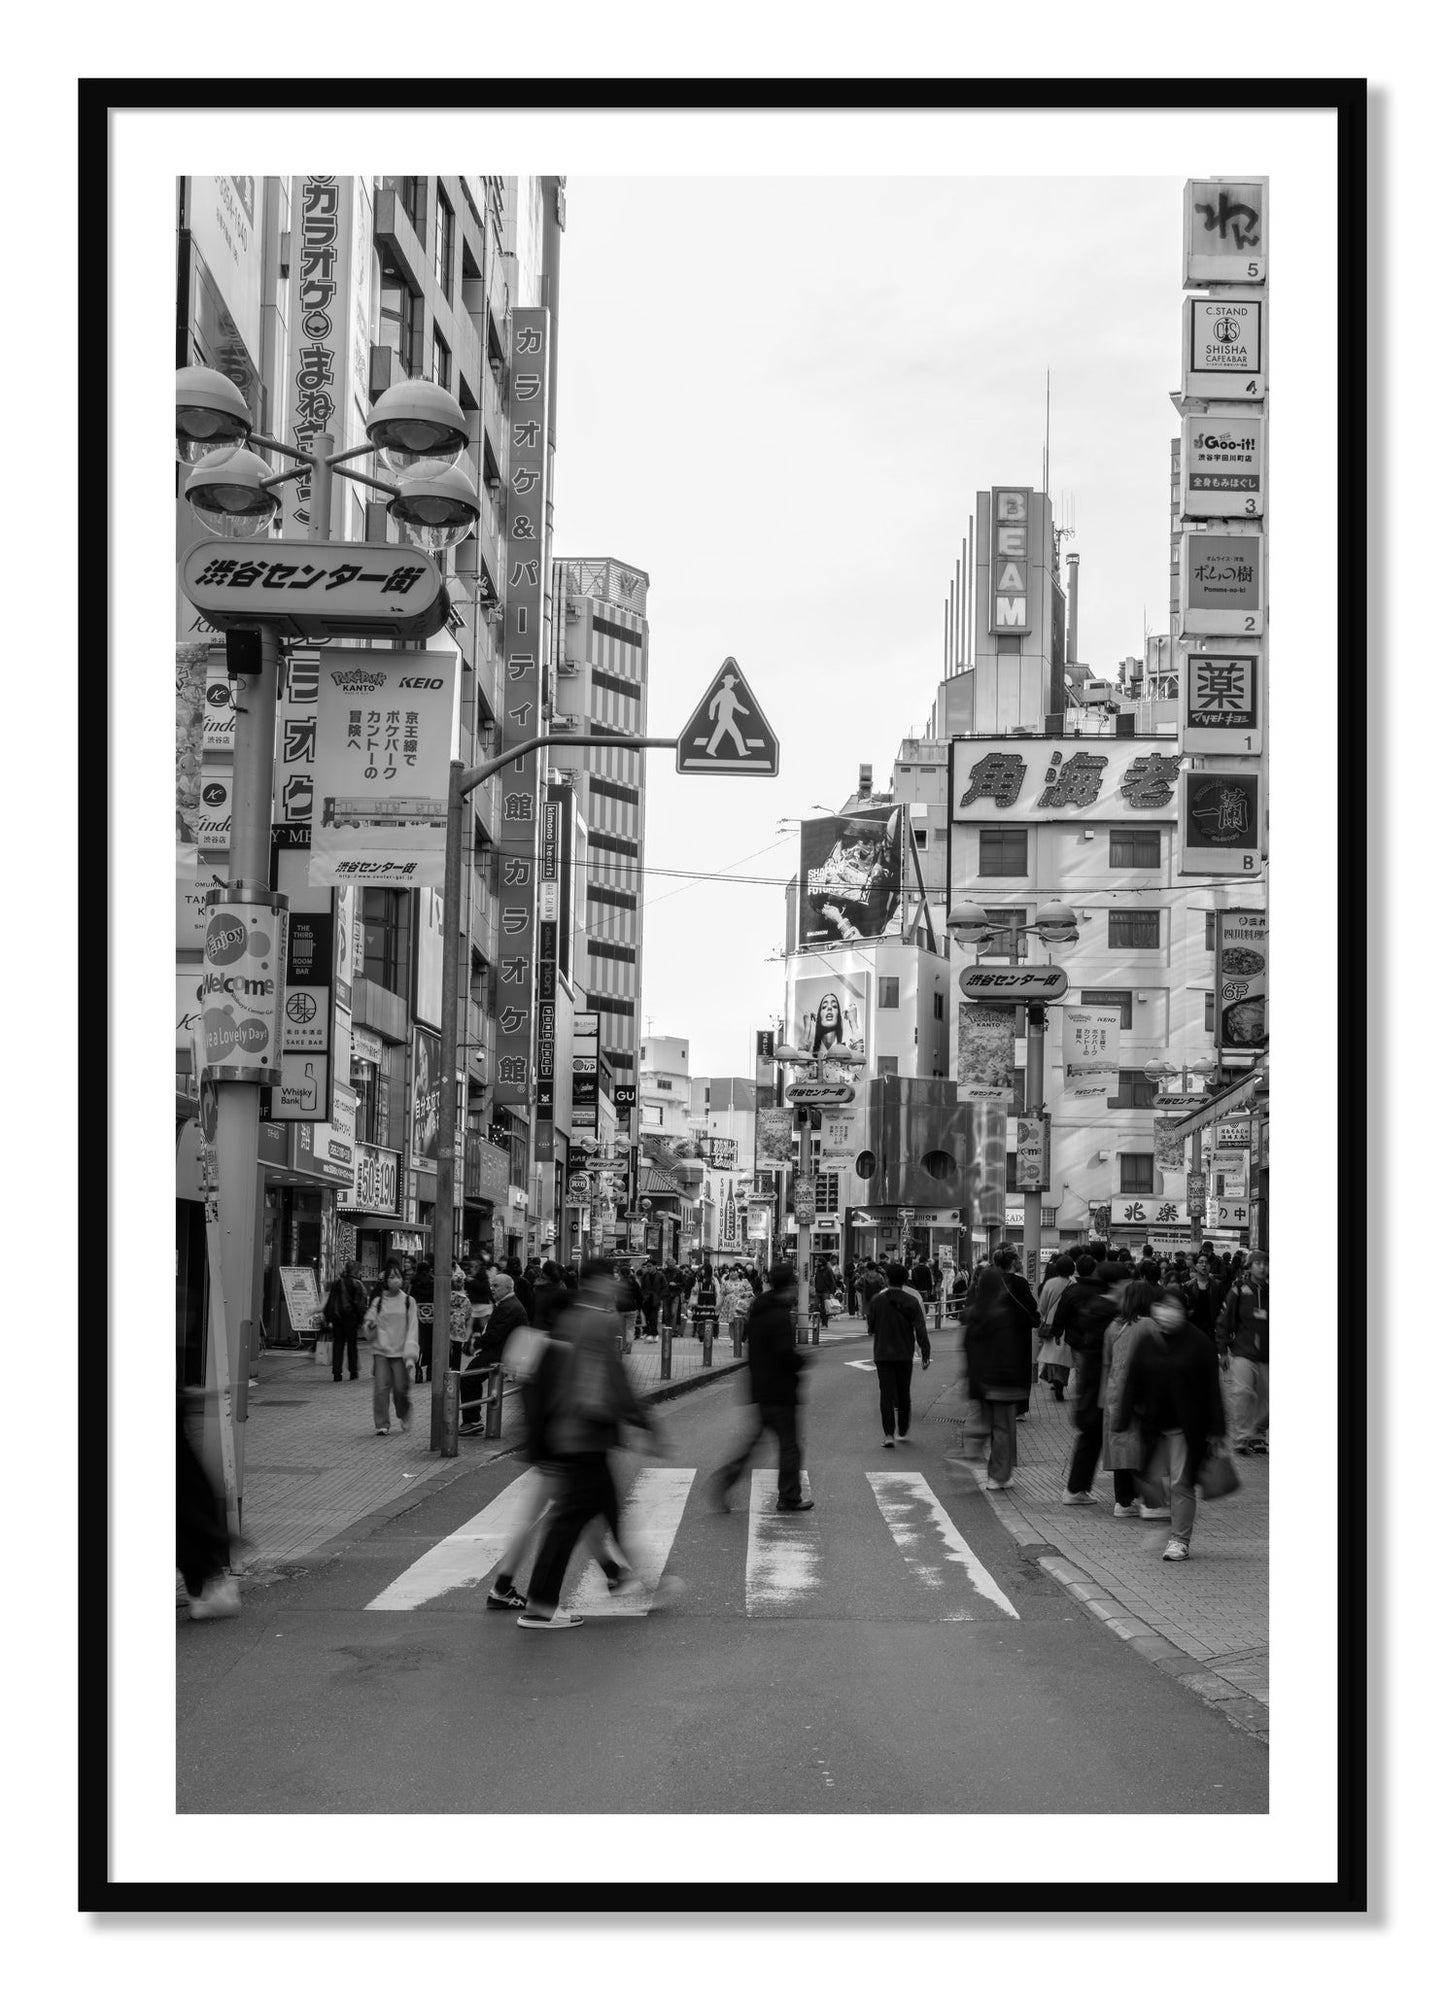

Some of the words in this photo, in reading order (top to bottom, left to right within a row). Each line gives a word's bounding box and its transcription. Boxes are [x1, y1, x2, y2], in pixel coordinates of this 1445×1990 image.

[300, 184, 338, 312] カラオケ
[1248, 262, 1259, 277] 5
[1206, 307, 1248, 316] C.STAND
[1206, 344, 1247, 355] SHISHA
[1246, 380, 1257, 395] 4
[1204, 435, 1255, 450] Goo-it!
[1193, 477, 1256, 489] 全身もみほぐし
[1245, 498, 1256, 514] 3
[997, 492, 1026, 626] BEAM
[195, 558, 427, 594] 渋谷センター街
[1245, 617, 1256, 631] 2
[398, 677, 443, 689] KEIO
[1197, 662, 1244, 709] 薬
[347, 710, 362, 750] 冒険へ
[364, 710, 380, 779] カントーの
[403, 712, 418, 766] 京王線で
[1244, 736, 1252, 750] 1
[960, 751, 1180, 808] 角海老
[1192, 787, 1248, 833] 一蘭
[546, 807, 555, 840] kimono
[335, 861, 418, 873] 渋谷センター街
[1243, 855, 1254, 870] B
[208, 925, 244, 959] Enjoy
[498, 858, 531, 1085] カラオケ館
[966, 974, 1062, 986] 渋谷センター街
[204, 973, 275, 996] Welcome
[1222, 982, 1249, 1000] 6F
[219, 1025, 247, 1044] Lovely
[249, 1027, 267, 1040] Day!
[281, 1087, 313, 1099] Whisky
[281, 1097, 300, 1105] Bank
[616, 1091, 635, 1101] GU
[1124, 1201, 1180, 1221] 兆楽
